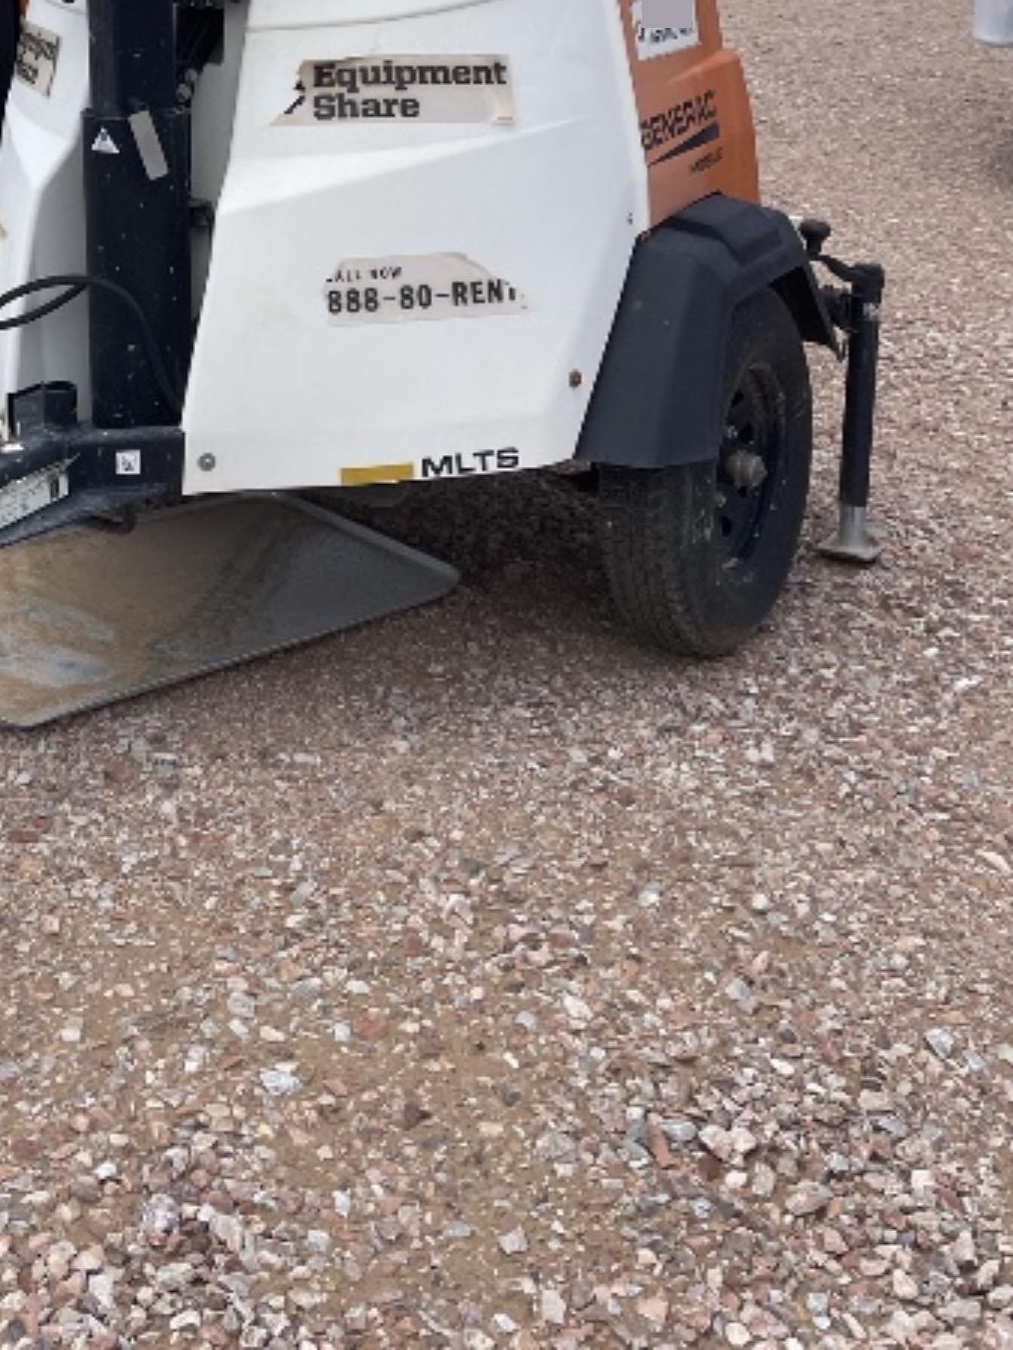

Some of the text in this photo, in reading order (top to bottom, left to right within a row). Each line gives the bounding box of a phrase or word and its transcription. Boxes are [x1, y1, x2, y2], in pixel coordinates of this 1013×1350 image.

[313, 60, 507, 93] Equipment
[313, 93, 420, 120] Share
[326, 269, 363, 282] ALL
